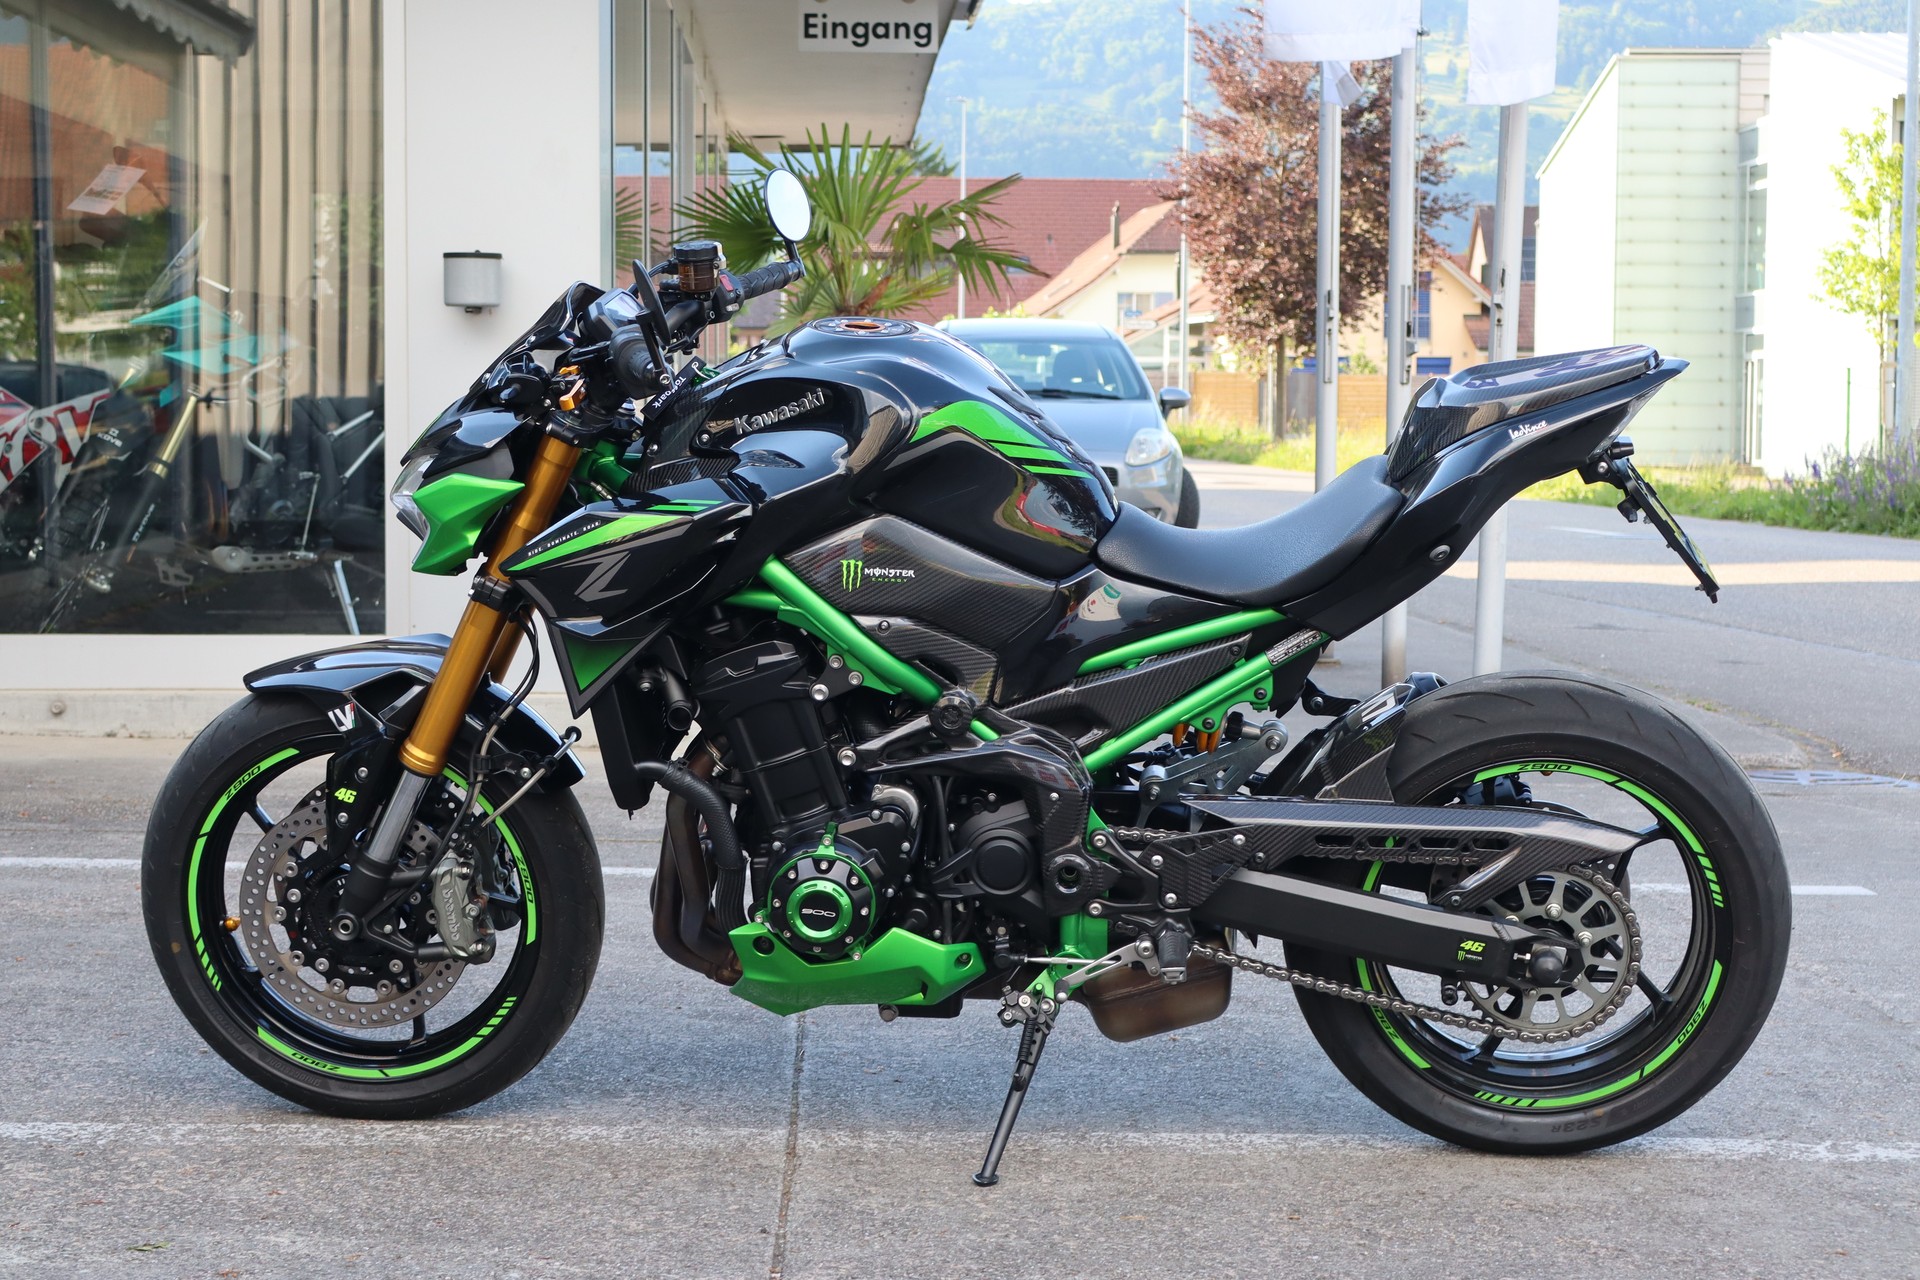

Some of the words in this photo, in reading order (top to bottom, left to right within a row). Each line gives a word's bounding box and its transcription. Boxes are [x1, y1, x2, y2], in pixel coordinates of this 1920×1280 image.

[803, 13, 932, 48] Eingang
[733, 387, 826, 435] Kawasaki
[864, 567, 916, 578] MONSTER
[1517, 762, 1572, 772] Z900
[225, 765, 261, 800] Z900
[334, 787, 357, 804] 46
[516, 855, 533, 904] Z900
[442, 888, 460, 941] brembo
[801, 908, 836, 918] 900
[1460, 940, 1486, 952] 46
[1677, 1000, 1708, 1045] Z900
[291, 1051, 341, 1072] Z900
